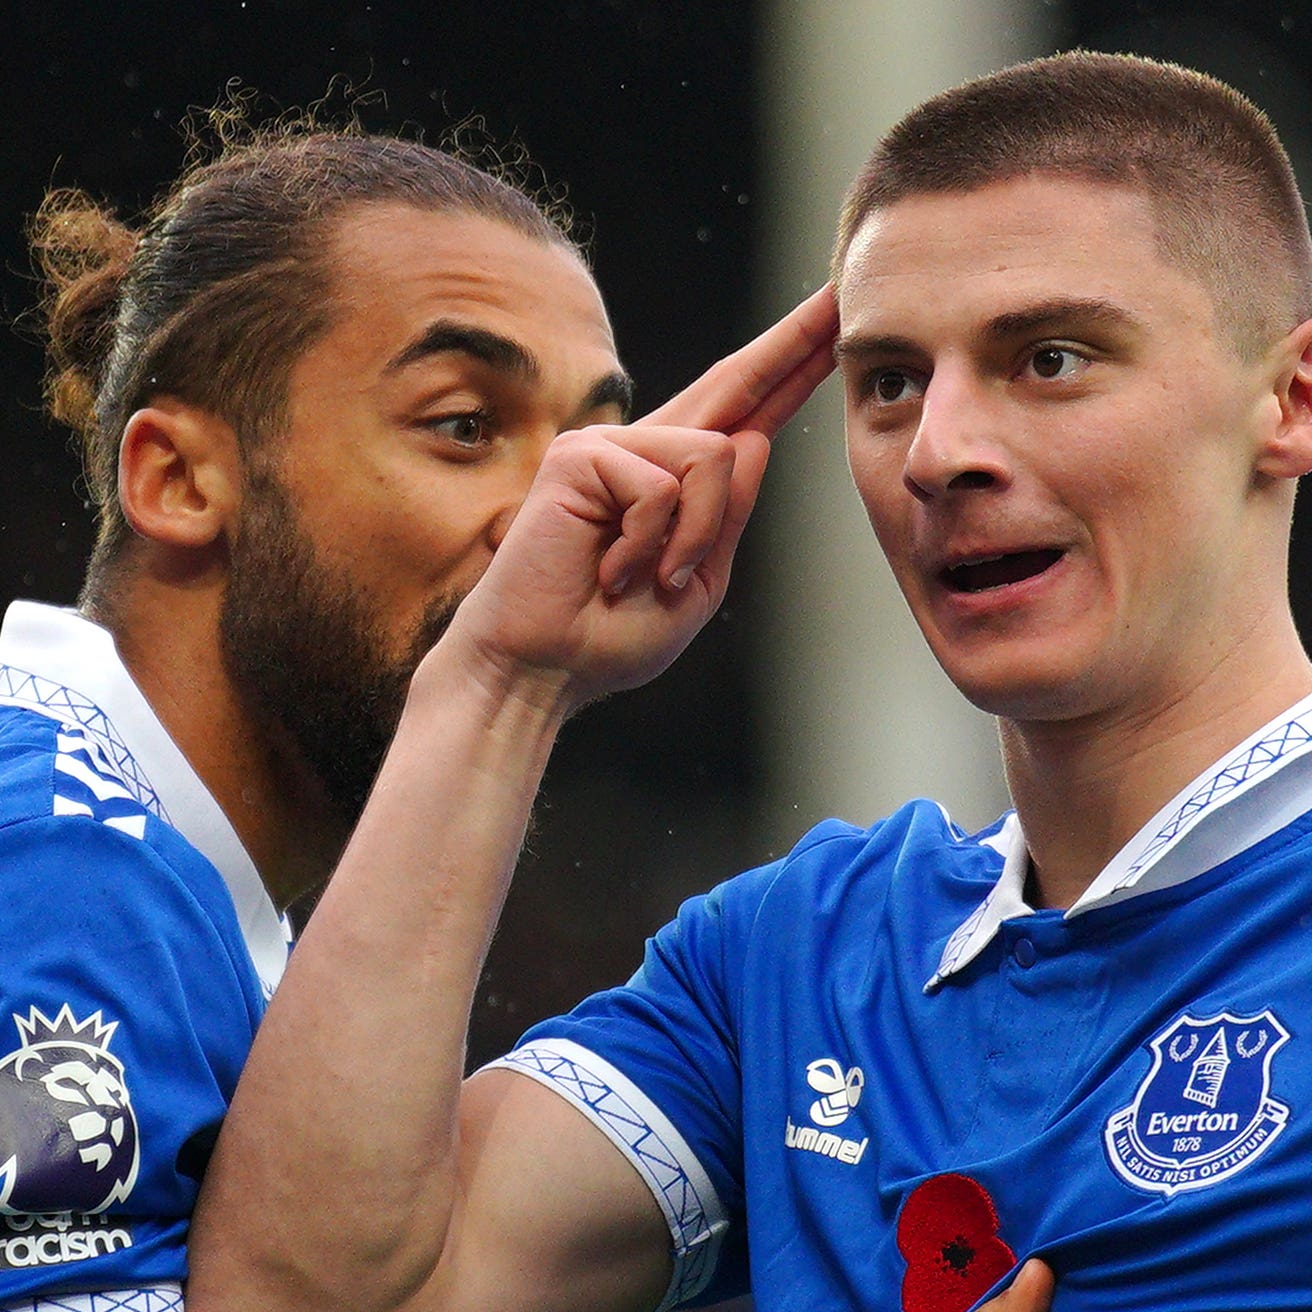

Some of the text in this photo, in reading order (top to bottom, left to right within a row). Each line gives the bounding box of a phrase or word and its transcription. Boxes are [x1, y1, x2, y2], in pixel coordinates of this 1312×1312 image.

[785, 1116, 869, 1166] ummel
[1146, 1110, 1238, 1136] Everton
[1116, 1128, 1268, 1183] NIL SATIS NISI OPTIMUM
[1172, 1137, 1202, 1153] 1878
